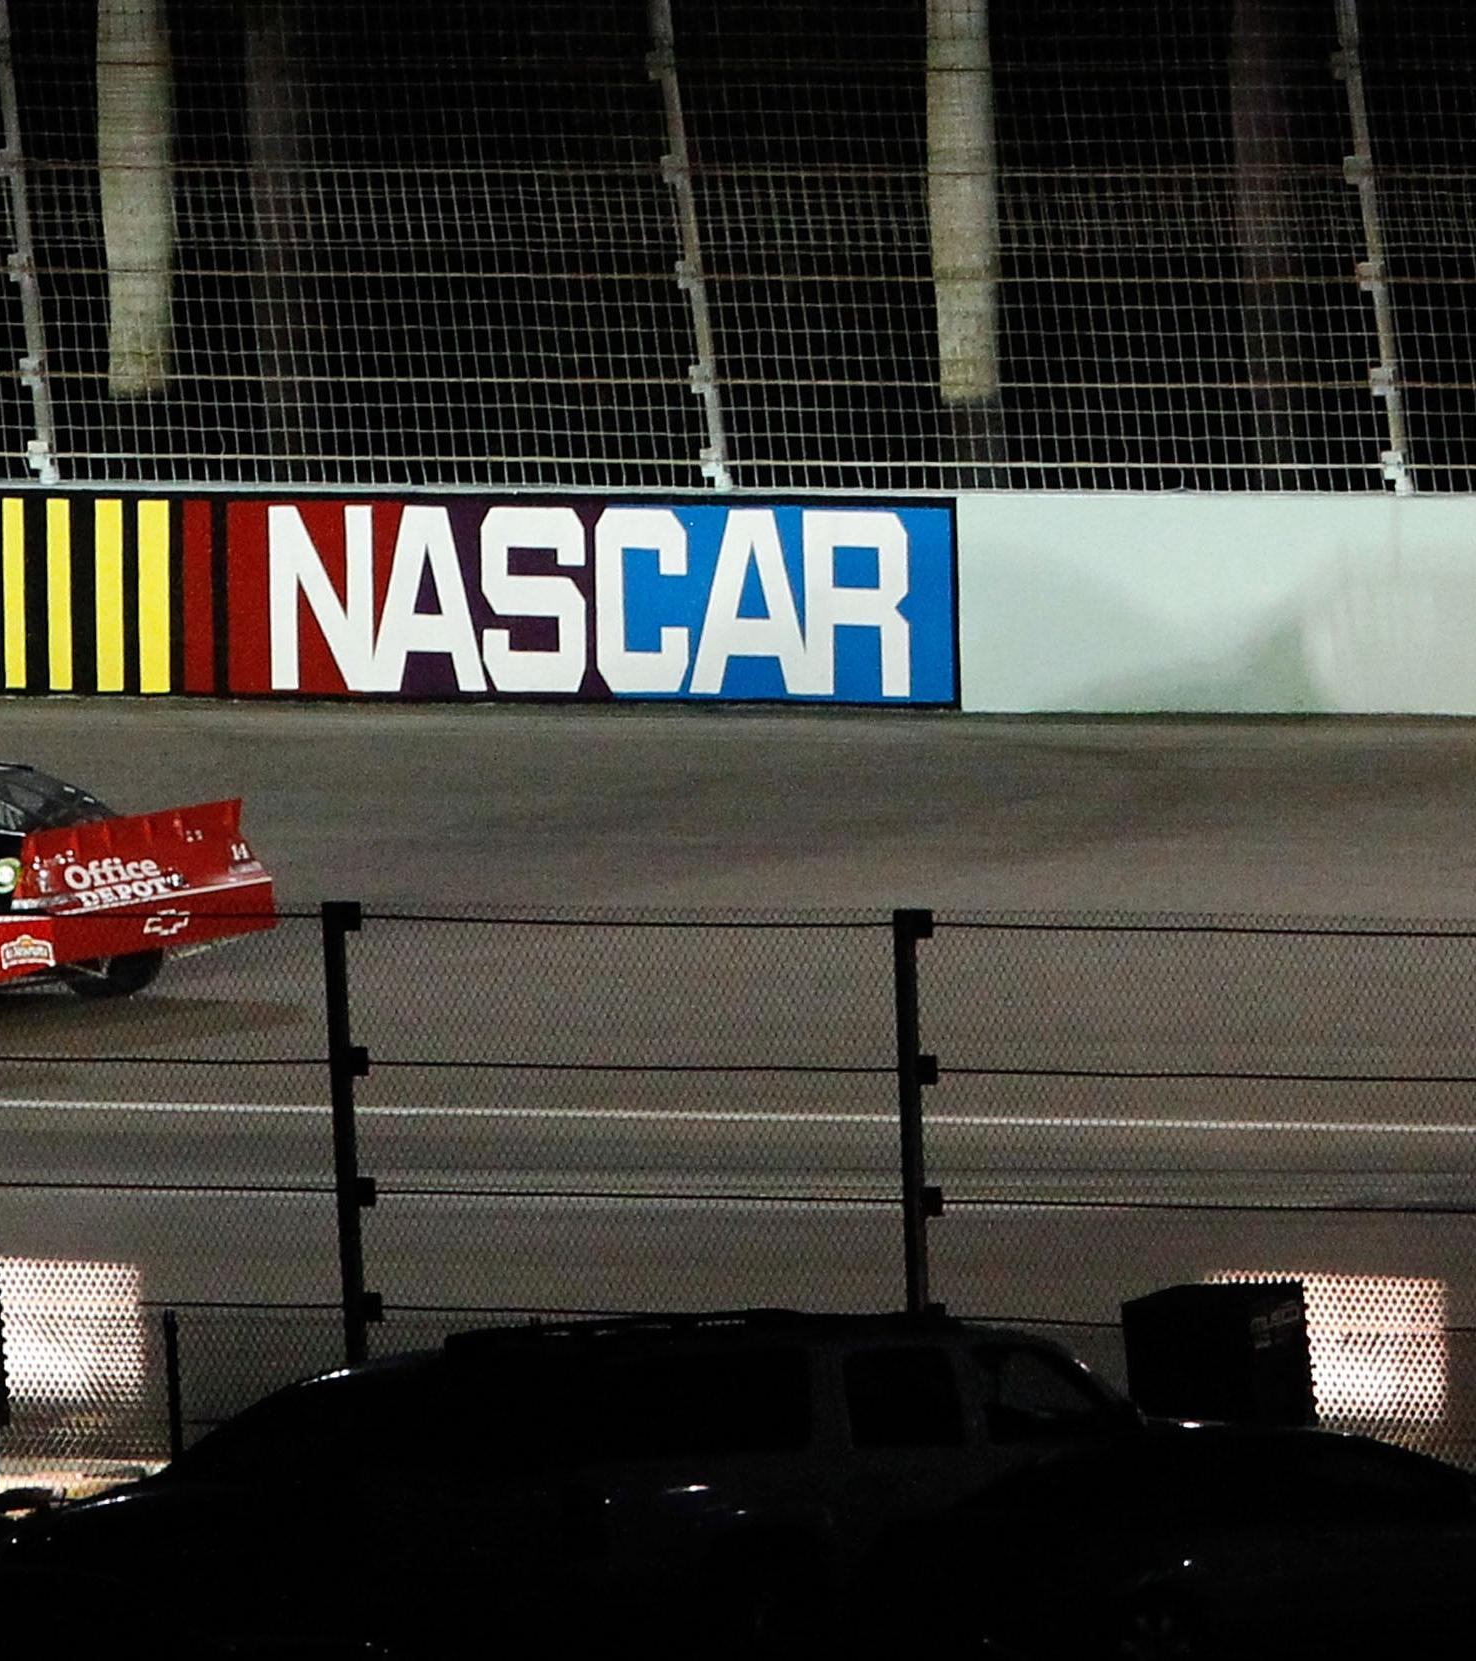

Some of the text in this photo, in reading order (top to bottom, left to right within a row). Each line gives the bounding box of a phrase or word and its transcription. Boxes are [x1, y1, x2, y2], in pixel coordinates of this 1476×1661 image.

[267, 504, 912, 698] NASCAR
[64, 856, 161, 891] Office
[75, 876, 169, 908] DEPOT
